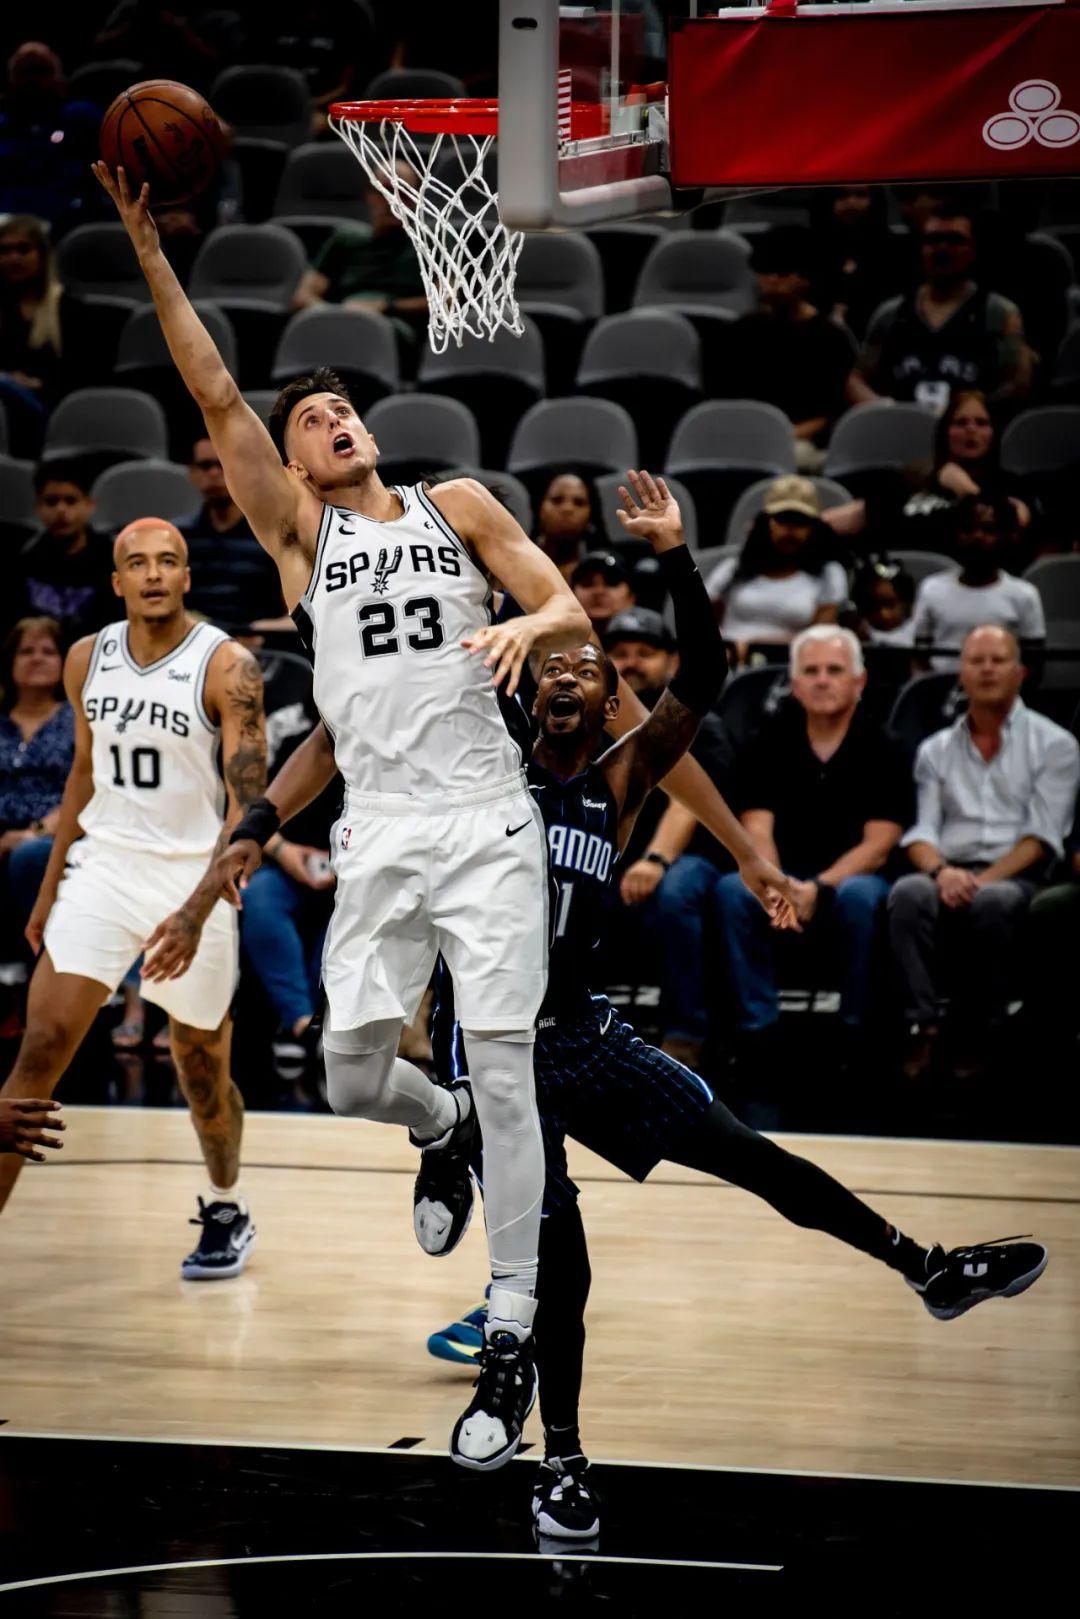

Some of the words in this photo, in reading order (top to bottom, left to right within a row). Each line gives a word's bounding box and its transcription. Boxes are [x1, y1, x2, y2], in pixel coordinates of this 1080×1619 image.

[326, 545, 461, 593] SPURS
[358, 597, 446, 659] 23
[86, 697, 189, 737] SPURS
[110, 745, 160, 788] 10
